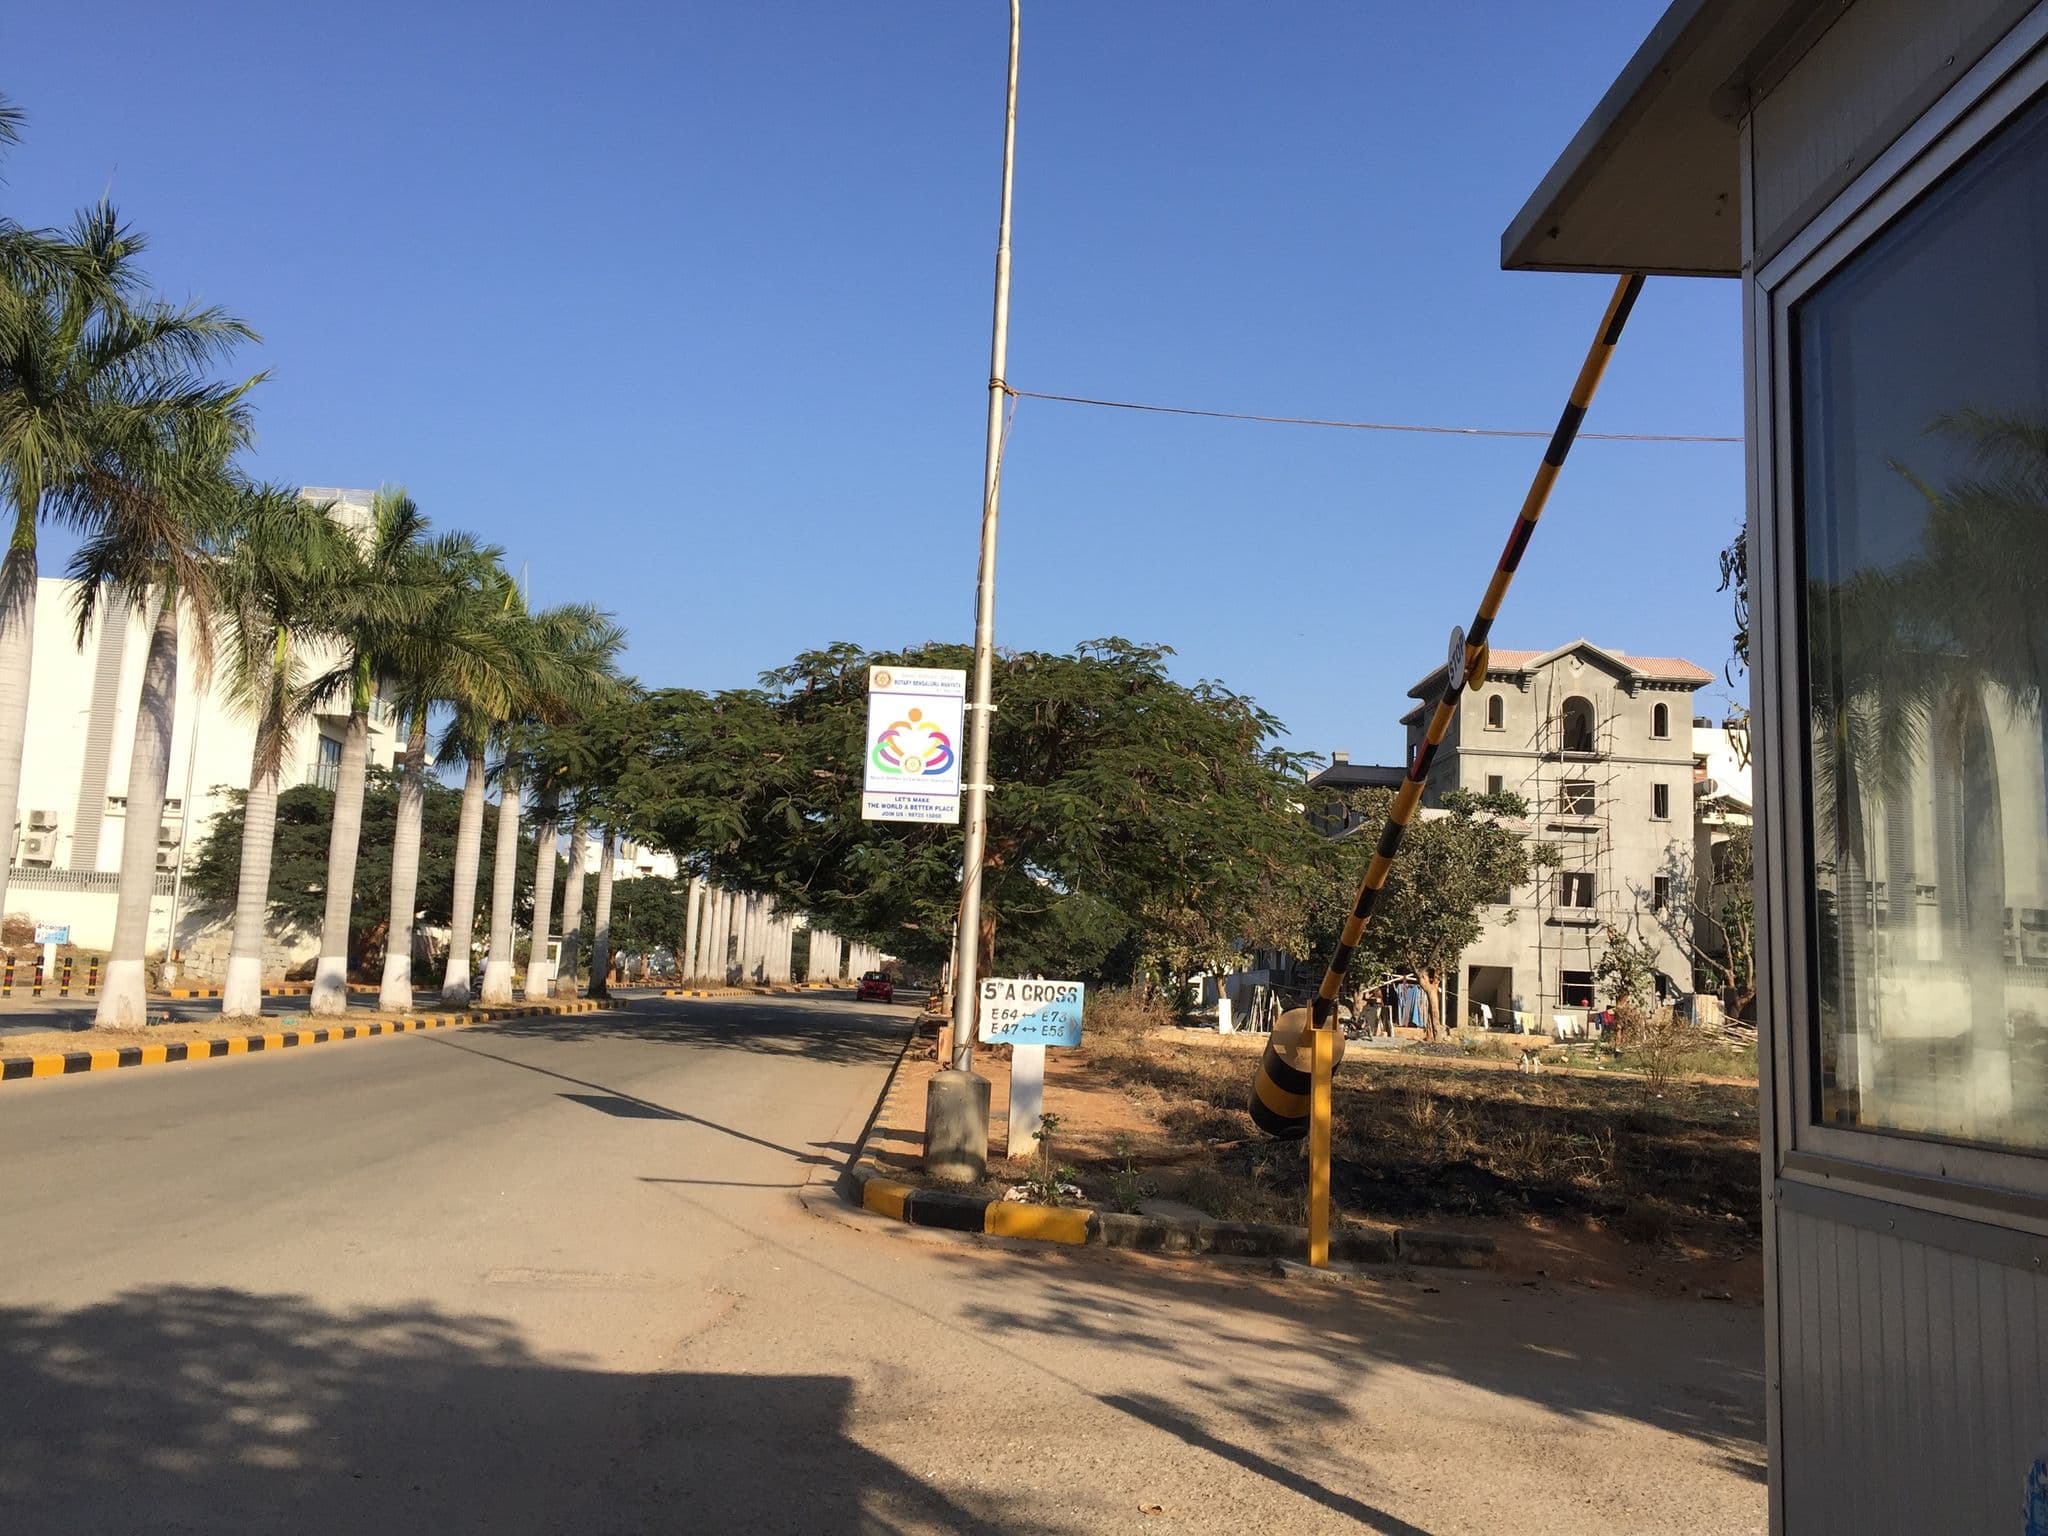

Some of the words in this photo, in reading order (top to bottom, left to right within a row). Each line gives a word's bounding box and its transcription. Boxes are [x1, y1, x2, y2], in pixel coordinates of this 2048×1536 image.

[1449, 633, 1464, 681] STOP
[1005, 983, 1016, 1001] A
[1022, 984, 1078, 1004] CROSS
